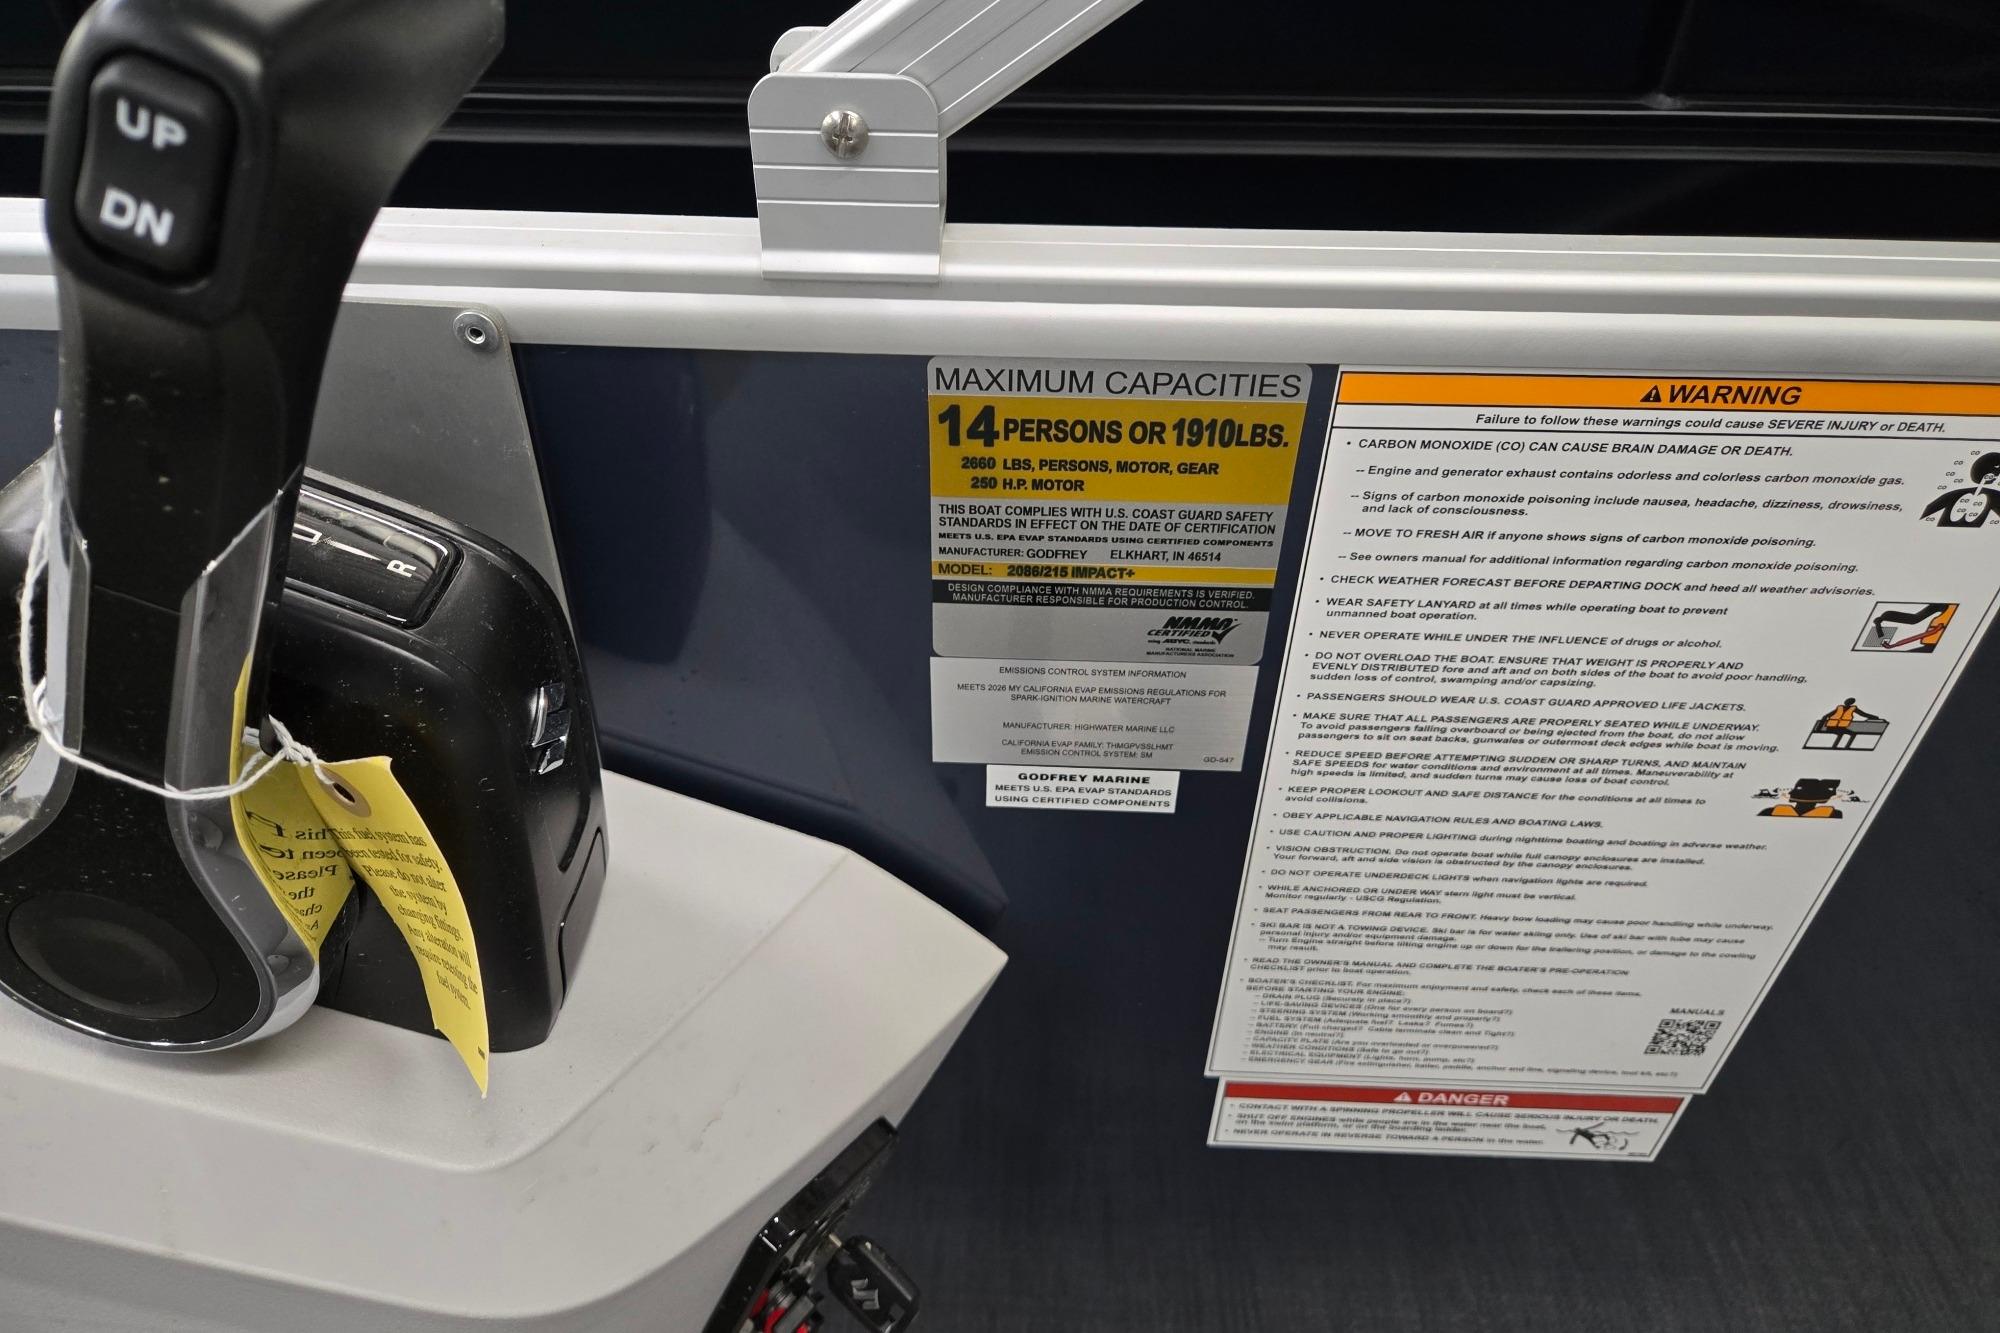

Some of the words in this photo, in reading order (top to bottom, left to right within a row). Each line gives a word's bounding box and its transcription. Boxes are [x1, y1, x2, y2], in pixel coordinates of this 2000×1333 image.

[116, 98, 187, 149] UP
[101, 186, 174, 246] DN
[935, 367, 1094, 393] MAXIMUM
[1105, 371, 1301, 398] CAPACITIES
[1669, 384, 1802, 405] WARNING
[938, 404, 999, 447] 14
[1003, 418, 1123, 445] PERSONS
[1128, 420, 1166, 444] OR
[1475, 414, 1520, 424] Failure
[1524, 415, 1536, 424] to
[1540, 415, 1580, 425] follow
[1583, 416, 1618, 426] these
[1622, 417, 1681, 429] warnings
[1685, 418, 1722, 428] could
[1725, 420, 1764, 428] cause
[1767, 419, 1825, 429] SEVERE
[1826, 420, 1878, 430] INJURY
[1896, 422, 1945, 432] DEATH.
[1358, 438, 1416, 449] CARBON
[1420, 440, 1493, 450] MONOXIDE
[1496, 441, 1525, 453] (CO)
[1529, 441, 1558, 451] CAN
[1561, 442, 1609, 452] CAUSE
[1611, 443, 1654, 453] BRAIN
[1657, 444, 1718, 454] DAMAGE
[1720, 445, 1741, 455] OR
[1744, 446, 1793, 456] DEATH.
[961, 456, 996, 469] 2660
[1003, 458, 1036, 472] LBS,
[1038, 458, 1113, 474] PERSONS,
[1116, 460, 1173, 475] MOTOR,
[1176, 462, 1219, 475] GEAR
[970, 476, 997, 489] 250
[1002, 478, 1028, 490] H.P.
[1031, 478, 1084, 491] MOTOR
[939, 503, 965, 514] THIS
[969, 504, 1001, 515] BOAT
[1005, 505, 1067, 517] COMPLIES
[1070, 507, 1101, 517] WITH
[1105, 508, 1129, 518] U.S.
[1132, 508, 1175, 519] COAST
[1178, 509, 1222, 520] GUARD
[1225, 511, 1273, 521] SAFETY
[939, 516, 1011, 528] STANDARDS
[1015, 518, 1026, 528] IN
[1030, 519, 1077, 529] EFFECT
[1080, 520, 1098, 530] ON
[1101, 520, 1125, 531] THE
[1129, 521, 1161, 532] DATE
[1164, 522, 1181, 532] OF
[1184, 522, 1276, 534] CERTIFICATION
[938, 546, 1025, 556] MANUFACTURER:
[1026, 548, 1087, 559] GODFREY
[1110, 549, 1169, 562] ELKHART,
[1172, 551, 1184, 560] IN
[1187, 551, 1220, 561] 46514
[386, 559, 416, 578] R
[938, 562, 993, 575] MODEL:
[1006, 564, 1069, 578] 2086/215
[1070, 565, 1135, 579] IMPACT+
[948, 583, 984, 592] DESIGN
[987, 584, 1051, 594] COMPLIANCE
[1054, 586, 1079, 594] WITH
[1082, 587, 1112, 595] NMMA
[1114, 587, 1193, 597] REQUIREMENTS
[1196, 590, 1205, 598] IS
[1208, 590, 1255, 599] VERIFIED.
[952, 592, 1033, 603] MANUFACTURER
[1036, 595, 1104, 605] RESPONSIBLE
[1107, 597, 1128, 605] FOR
[1130, 597, 1196, 607] PRODUCTION
[1199, 599, 1249, 608] CONTROL.
[1319, 630, 1360, 639] NEVER
[1363, 631, 1420, 640] OPERATE
[1424, 633, 1462, 641] WHILE
[1465, 634, 1508, 642] UNDER
[1512, 634, 1536, 643] THE
[1538, 635, 1608, 645] INFLUENCE
[1625, 638, 1658, 648] drugs
[1676, 639, 1722, 647] alcohol.
[999, 666, 1046, 675] EMISSIONS
[1091, 668, 1125, 677] SYSTEM
[1128, 670, 1186, 678] INFORMATION
[1010, 694, 1077, 702] SPARK-IGNITION
[1098, 686, 1144, 695] EMISSIONS
[1146, 688, 1206, 696] REGULATIONS
[1002, 721, 1072, 730] MANUFACTURER:
[1074, 723, 1123, 731] HIGHWATER
[1018, 772, 1087, 782] GODFREY
[1092, 775, 1150, 784] MARINE
[1108, 788, 1171, 796] STANDARDS
[1092, 798, 1170, 807] COMPONENTS
[374, 831, 410, 844] system
[405, 831, 427, 846] has
[362, 864, 398, 878] Please
[396, 868, 410, 882] do
[1418, 1092, 1509, 1105] DANGER
